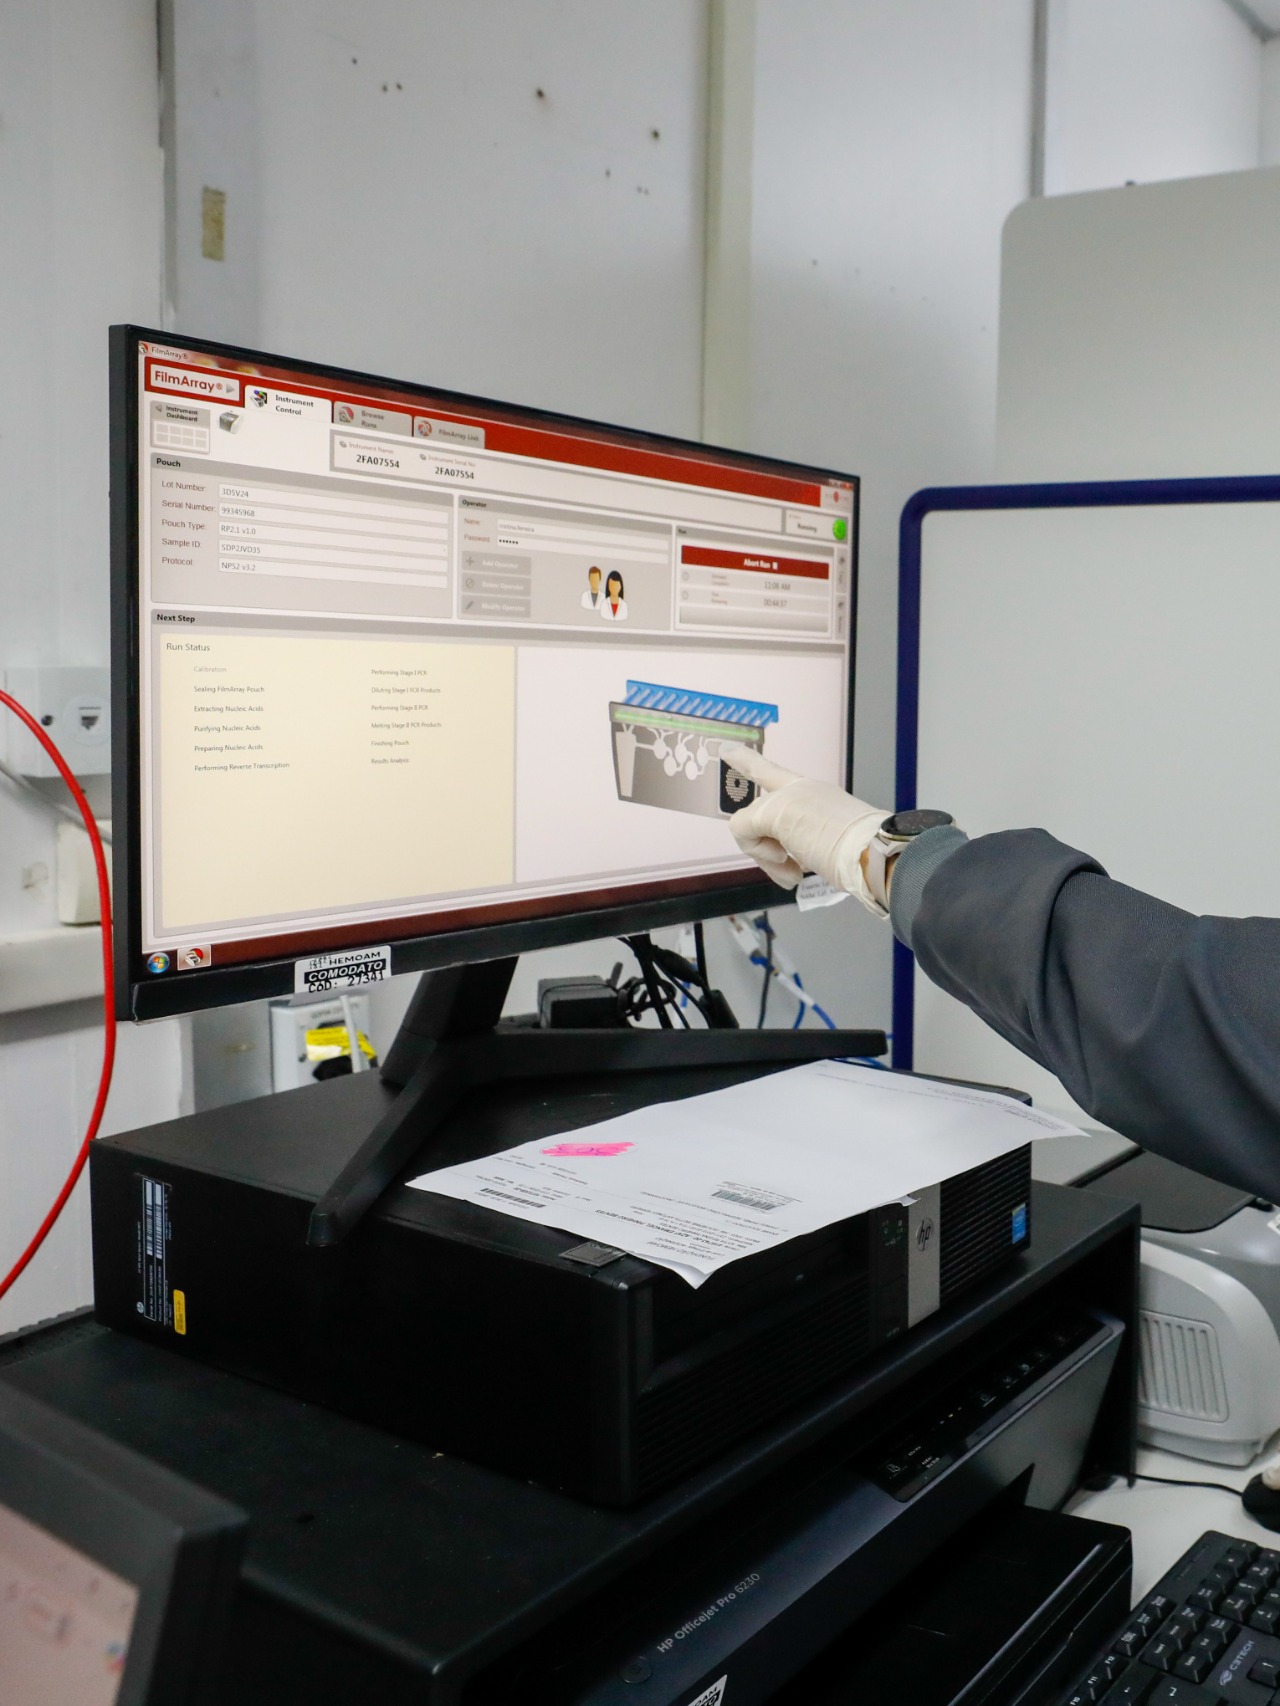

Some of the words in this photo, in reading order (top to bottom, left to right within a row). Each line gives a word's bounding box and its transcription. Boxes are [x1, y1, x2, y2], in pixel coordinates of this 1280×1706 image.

[276, 394, 314, 408] Instrument
[166, 405, 198, 416] Instrument
[276, 406, 302, 416] Control
[362, 410, 384, 420] Browse
[166, 412, 198, 422] Dashboard
[362, 421, 376, 429] Runs
[439, 429, 466, 440] FilmArray
[156, 458, 181, 468] Pouch
[356, 454, 400, 468] 2FA07554
[435, 466, 474, 480] 2FA07554
[162, 500, 183, 508] Serial
[462, 500, 487, 508] Operator
[222, 507, 255, 516] 99345968
[162, 520, 186, 528] Pouch
[221, 525, 240, 534] RP2.1
[162, 538, 190, 548] Sample
[744, 558, 758, 568] Abort
[760, 560, 770, 569] Run
[178, 615, 195, 624] Step
[330, 952, 380, 966] HEMOAM
[308, 961, 382, 982] COMODATO
[348, 970, 384, 986] 27341
[657, 1638, 674, 1652] HP
[716, 1593, 736, 1607] Pro
[735, 1574, 760, 1593] 6230
